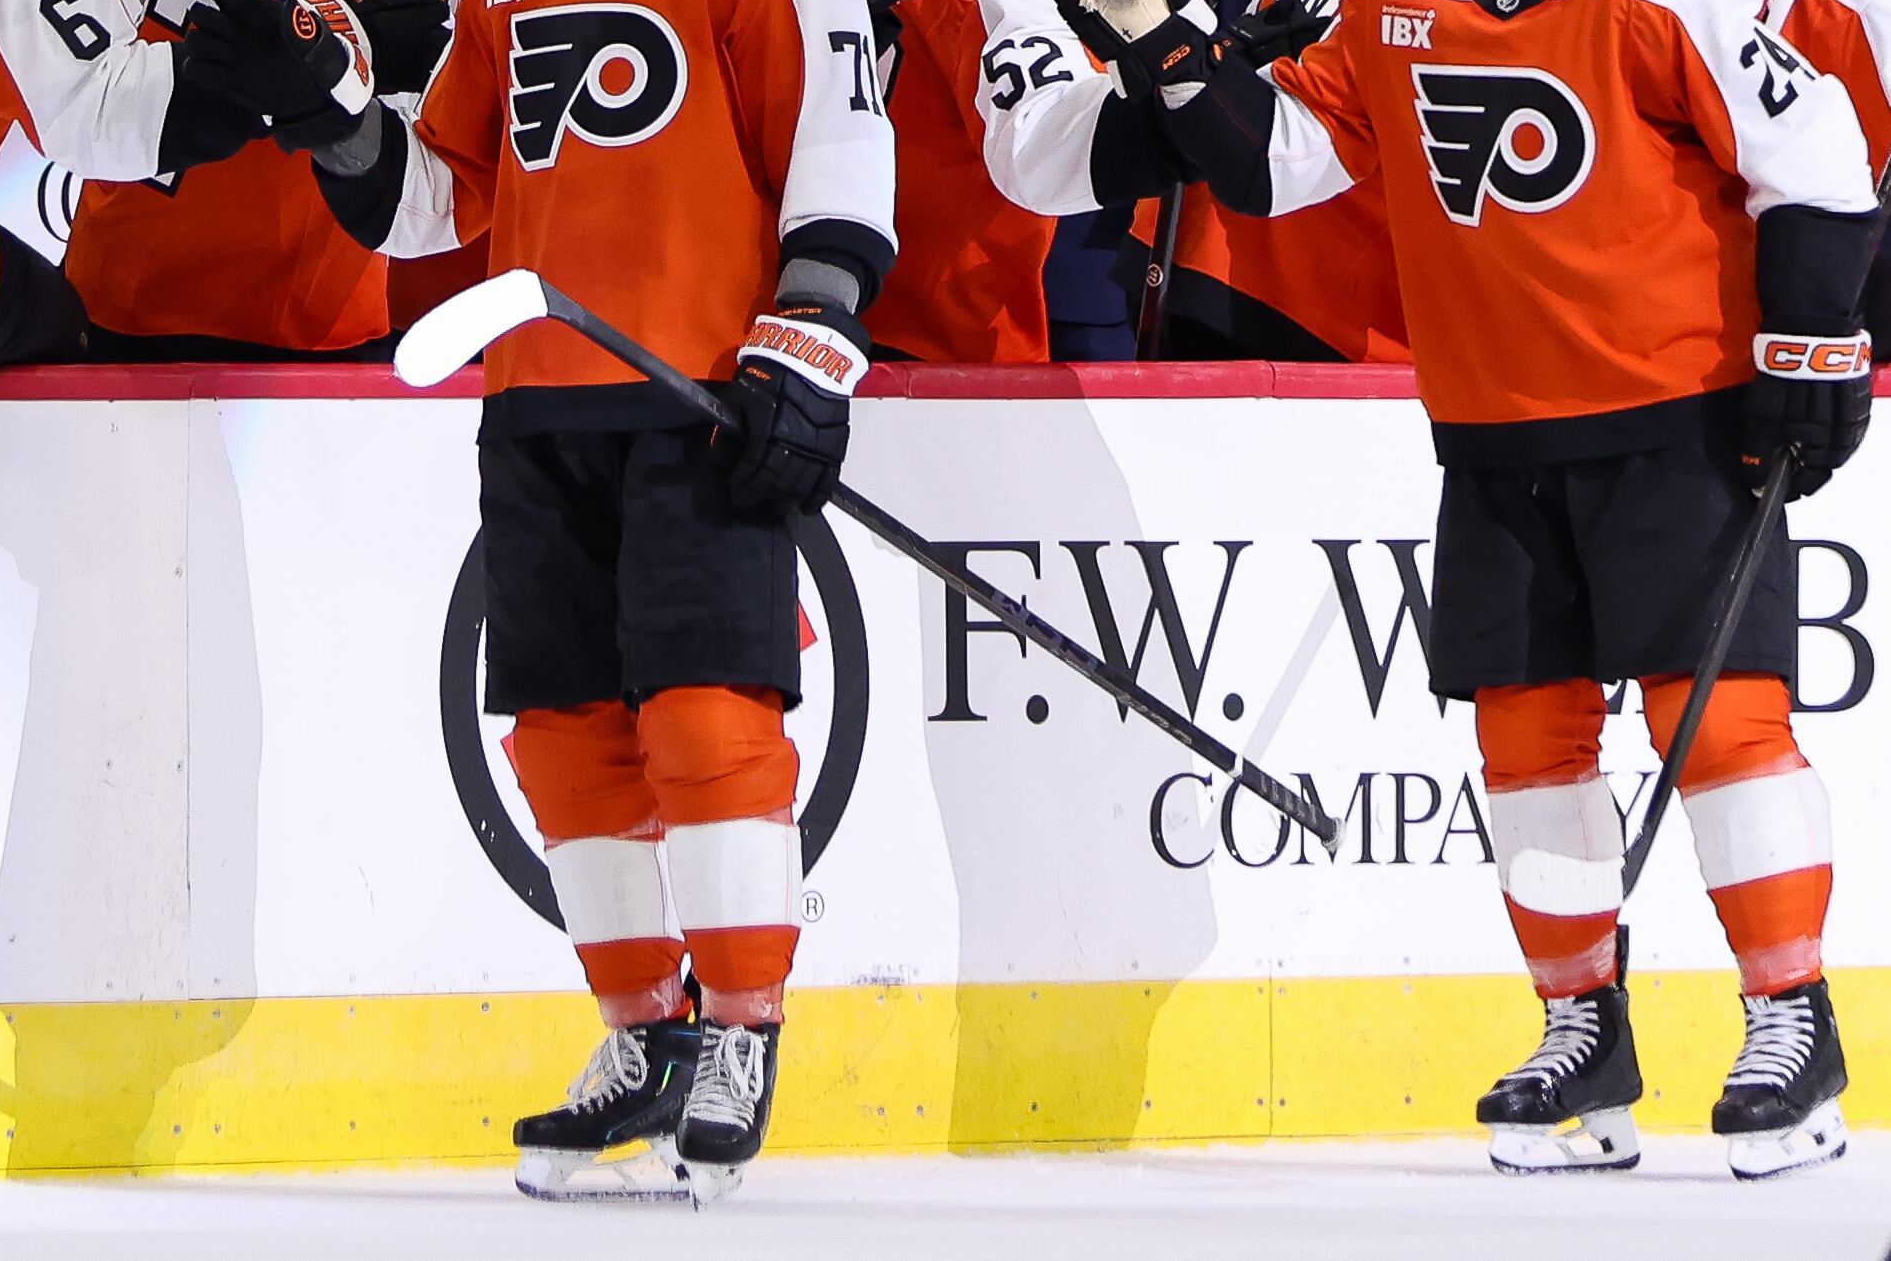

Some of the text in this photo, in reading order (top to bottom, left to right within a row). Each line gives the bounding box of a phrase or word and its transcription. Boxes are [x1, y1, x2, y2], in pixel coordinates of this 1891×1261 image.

[981, 36, 1074, 111] 52
[1380, 15, 1434, 50] IBX
[926, 538, 1875, 724] F.W. WB
[1148, 770, 1659, 869] COMPAY
